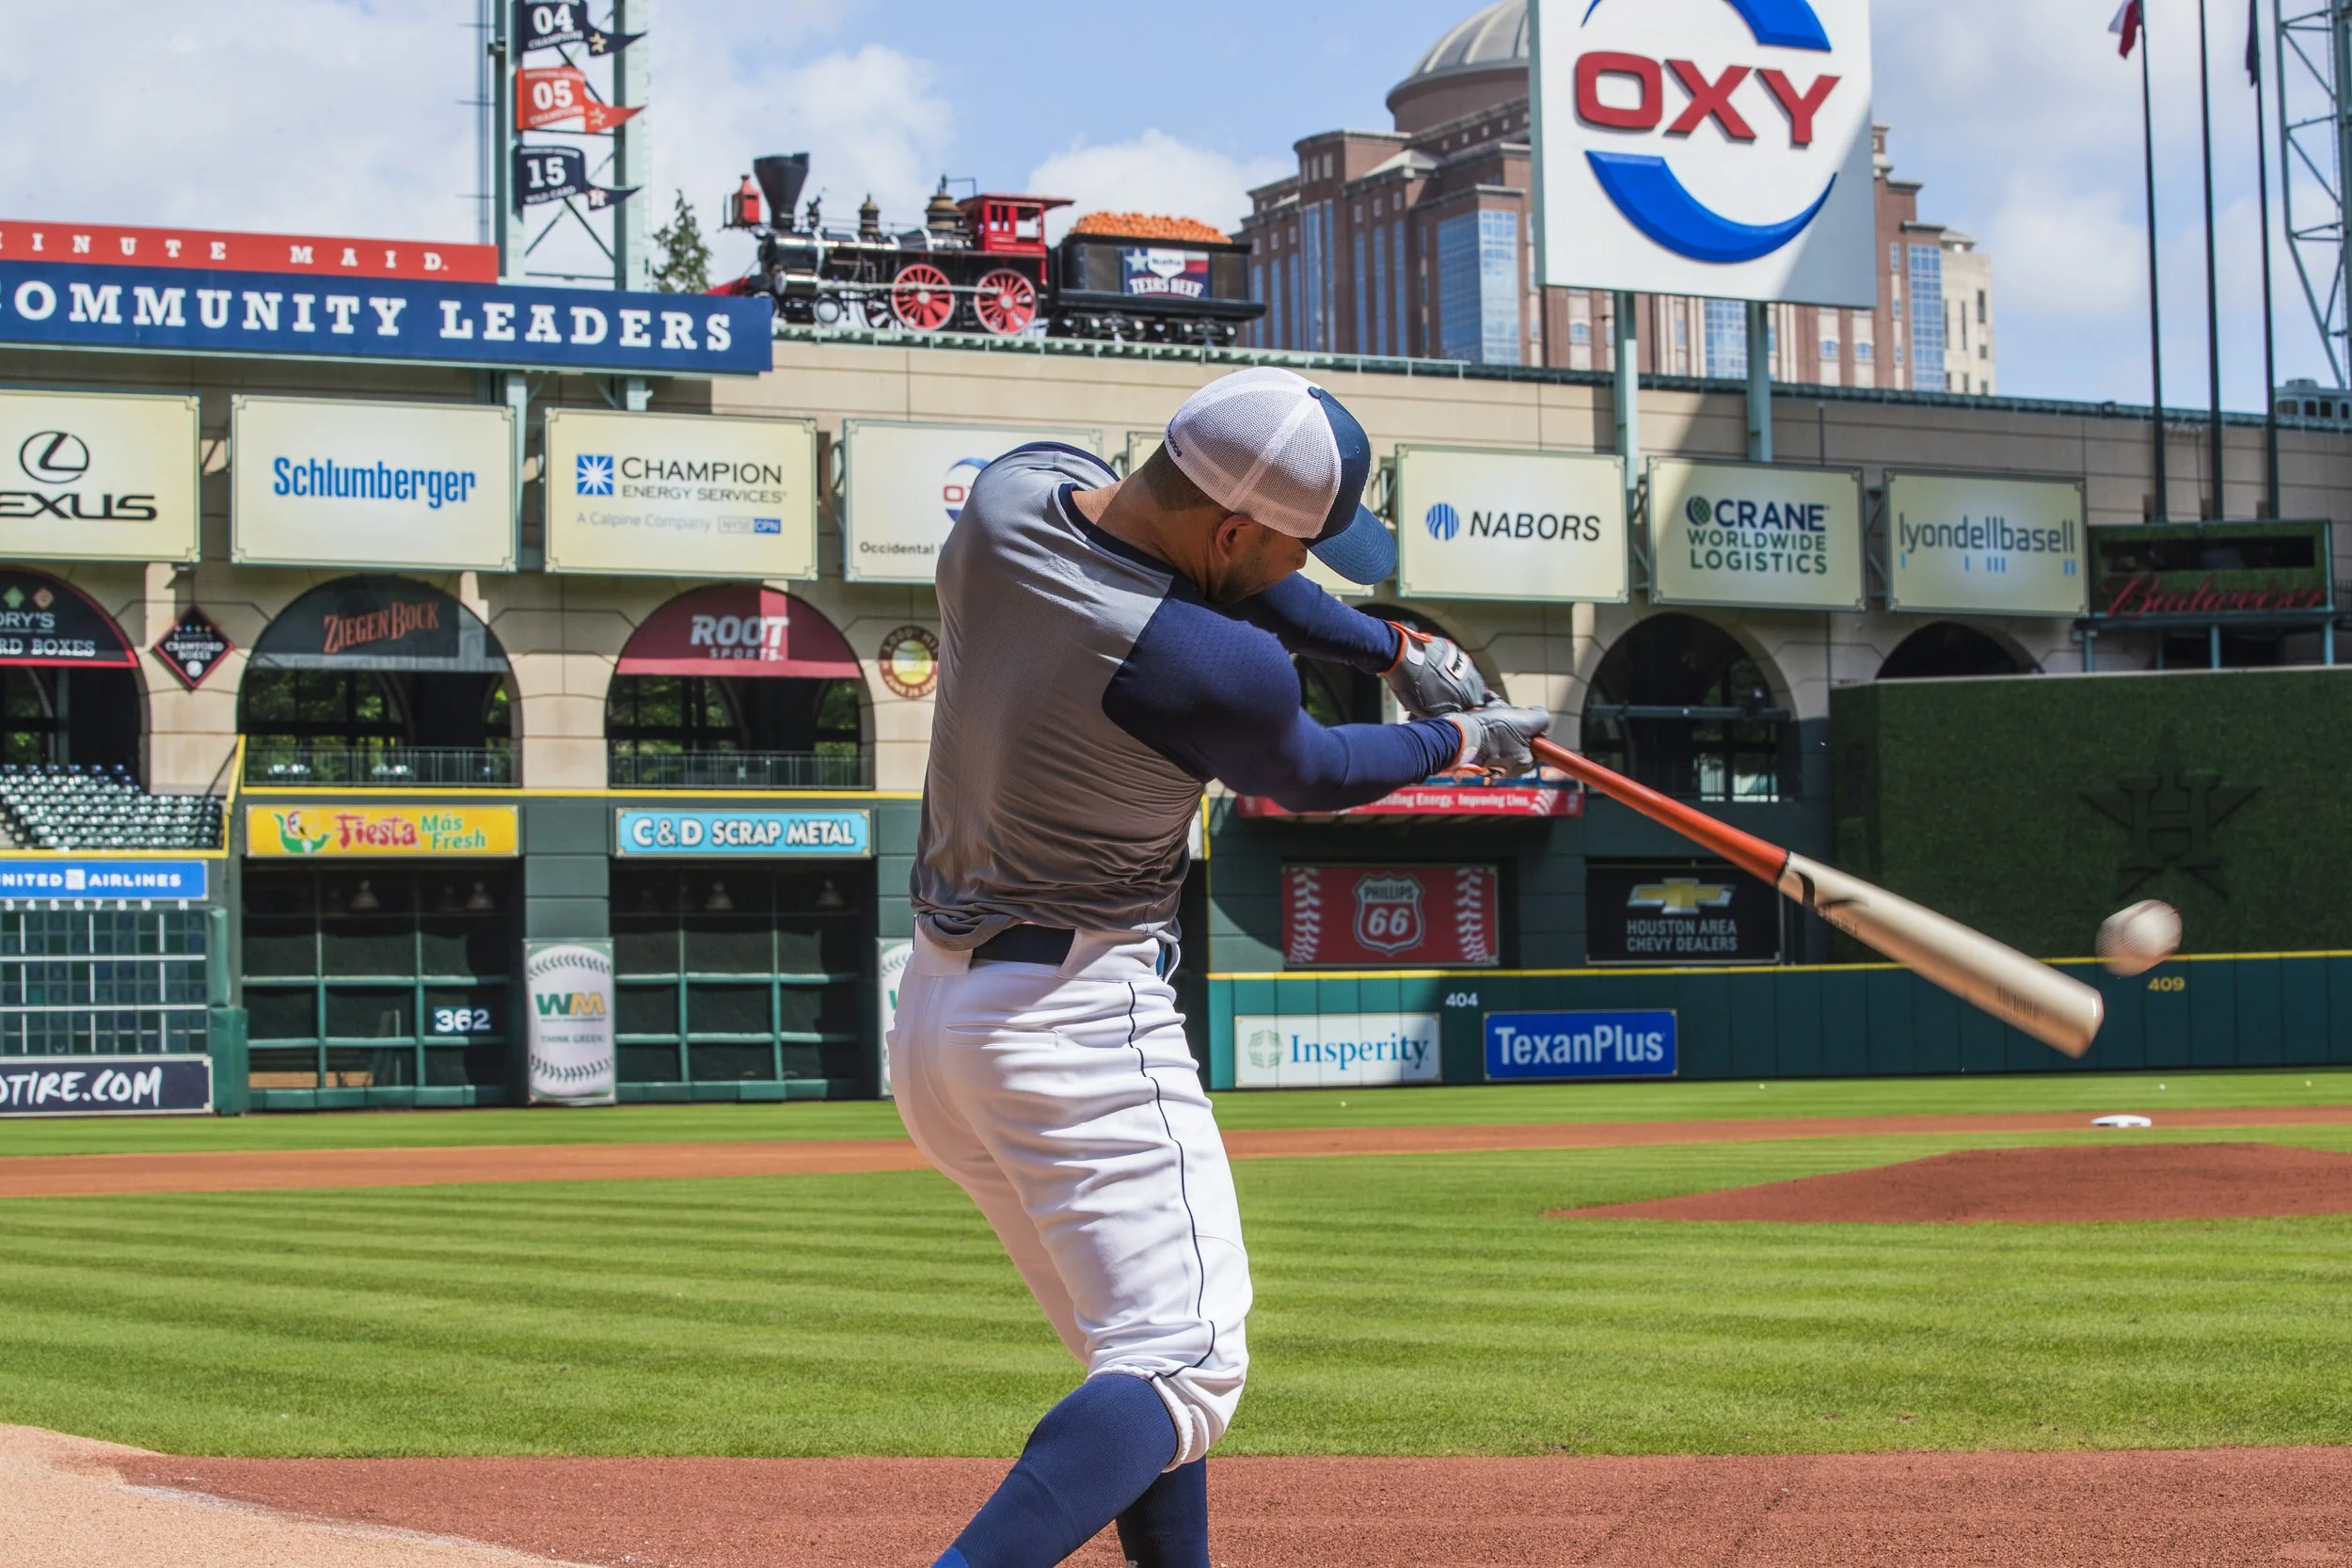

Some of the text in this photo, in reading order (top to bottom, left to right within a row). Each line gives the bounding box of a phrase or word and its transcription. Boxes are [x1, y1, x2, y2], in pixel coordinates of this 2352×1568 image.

[532, 4, 574, 35] 04
[532, 79, 573, 110] 05
[1574, 52, 1841, 147] OXY
[527, 156, 566, 188] 15
[0, 231, 227, 261] INUTE
[0, 280, 732, 352] OMMUNITY LEADERS
[273, 457, 475, 509] Schlumberger
[621, 457, 782, 484] CHAMPION
[0, 491, 157, 521] EXUS
[622, 484, 784, 504] ENERGY SERVICES
[576, 511, 712, 532] A Calpine Company
[1470, 511, 1601, 541] NABORS
[1715, 499, 1825, 532] CRANE
[1687, 529, 1827, 552] WORLDWIDE
[1899, 512, 2075, 553] lyondellbasell
[860, 541, 934, 555] Occidental
[1691, 549, 1827, 575] LOGISTICS
[691, 615, 790, 647] ROOT
[31, 639, 96, 657] BOXES
[709, 647, 778, 661] SPORTS
[335, 812, 463, 849] Fiesta Más
[432, 829, 487, 851] Fresh
[632, 818, 855, 846] C & D SCRAP METAL
[0, 873, 182, 887] NITED AIRLINES
[1365, 885, 1414, 900] PHILLIPS
[26, 899, 36, 911] 4
[74, 899, 85, 911] 6
[1369, 907, 1410, 936] 66
[1627, 919, 1738, 935] HOUSTON AREA
[1627, 936, 1738, 952] CHEVY DEALERS
[2148, 976, 2185, 991] 409
[535, 992, 606, 1016] WM
[1445, 992, 1478, 1007] 404
[435, 1008, 491, 1032] 362
[1291, 1032, 1429, 1070] Insperity
[1494, 1024, 1663, 1065] TexanPlus
